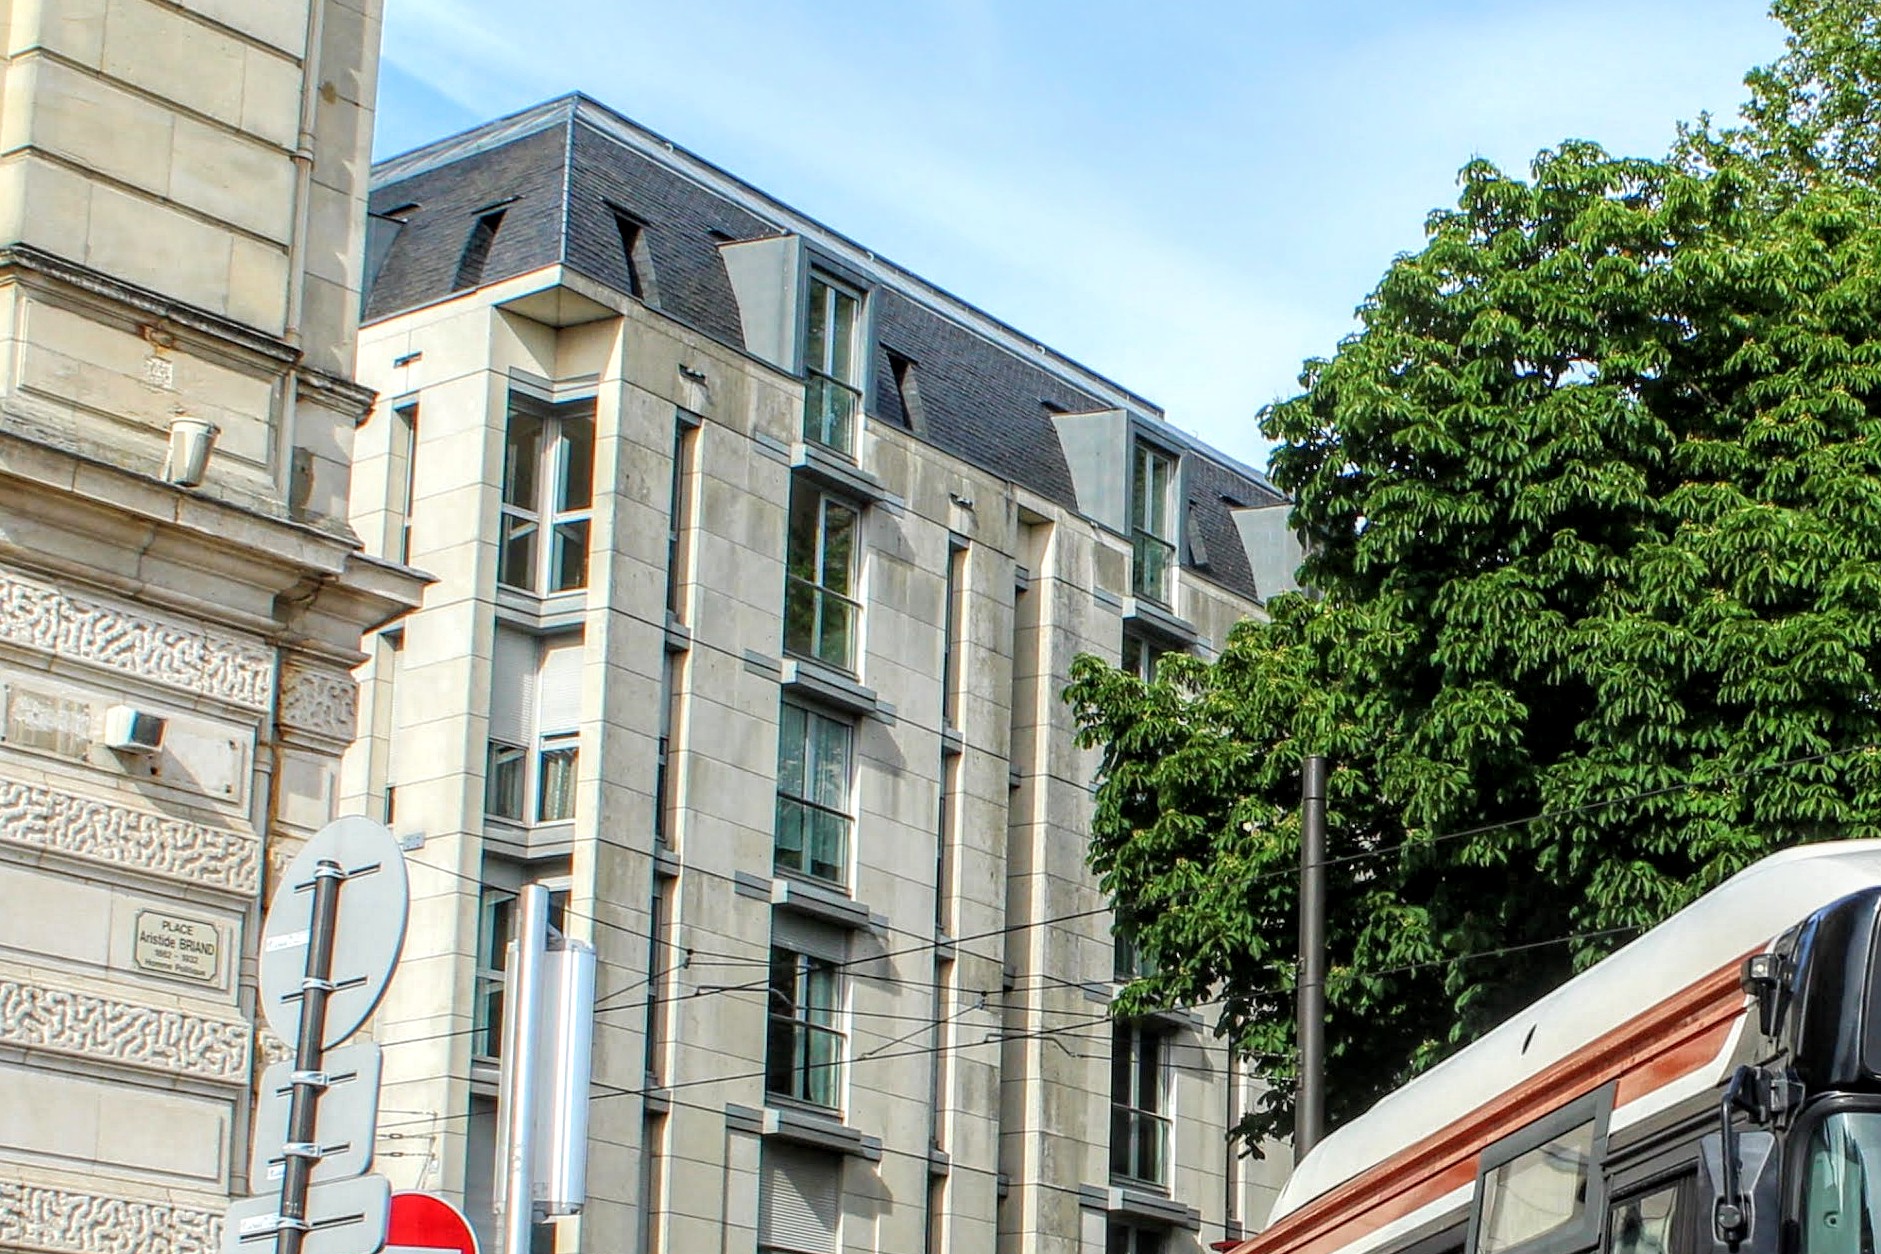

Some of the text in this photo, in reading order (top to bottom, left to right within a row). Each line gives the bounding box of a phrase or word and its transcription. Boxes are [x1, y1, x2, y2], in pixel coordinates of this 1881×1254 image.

[162, 920, 194, 936] PLACE
[140, 930, 215, 956] Aristide BRIAND
